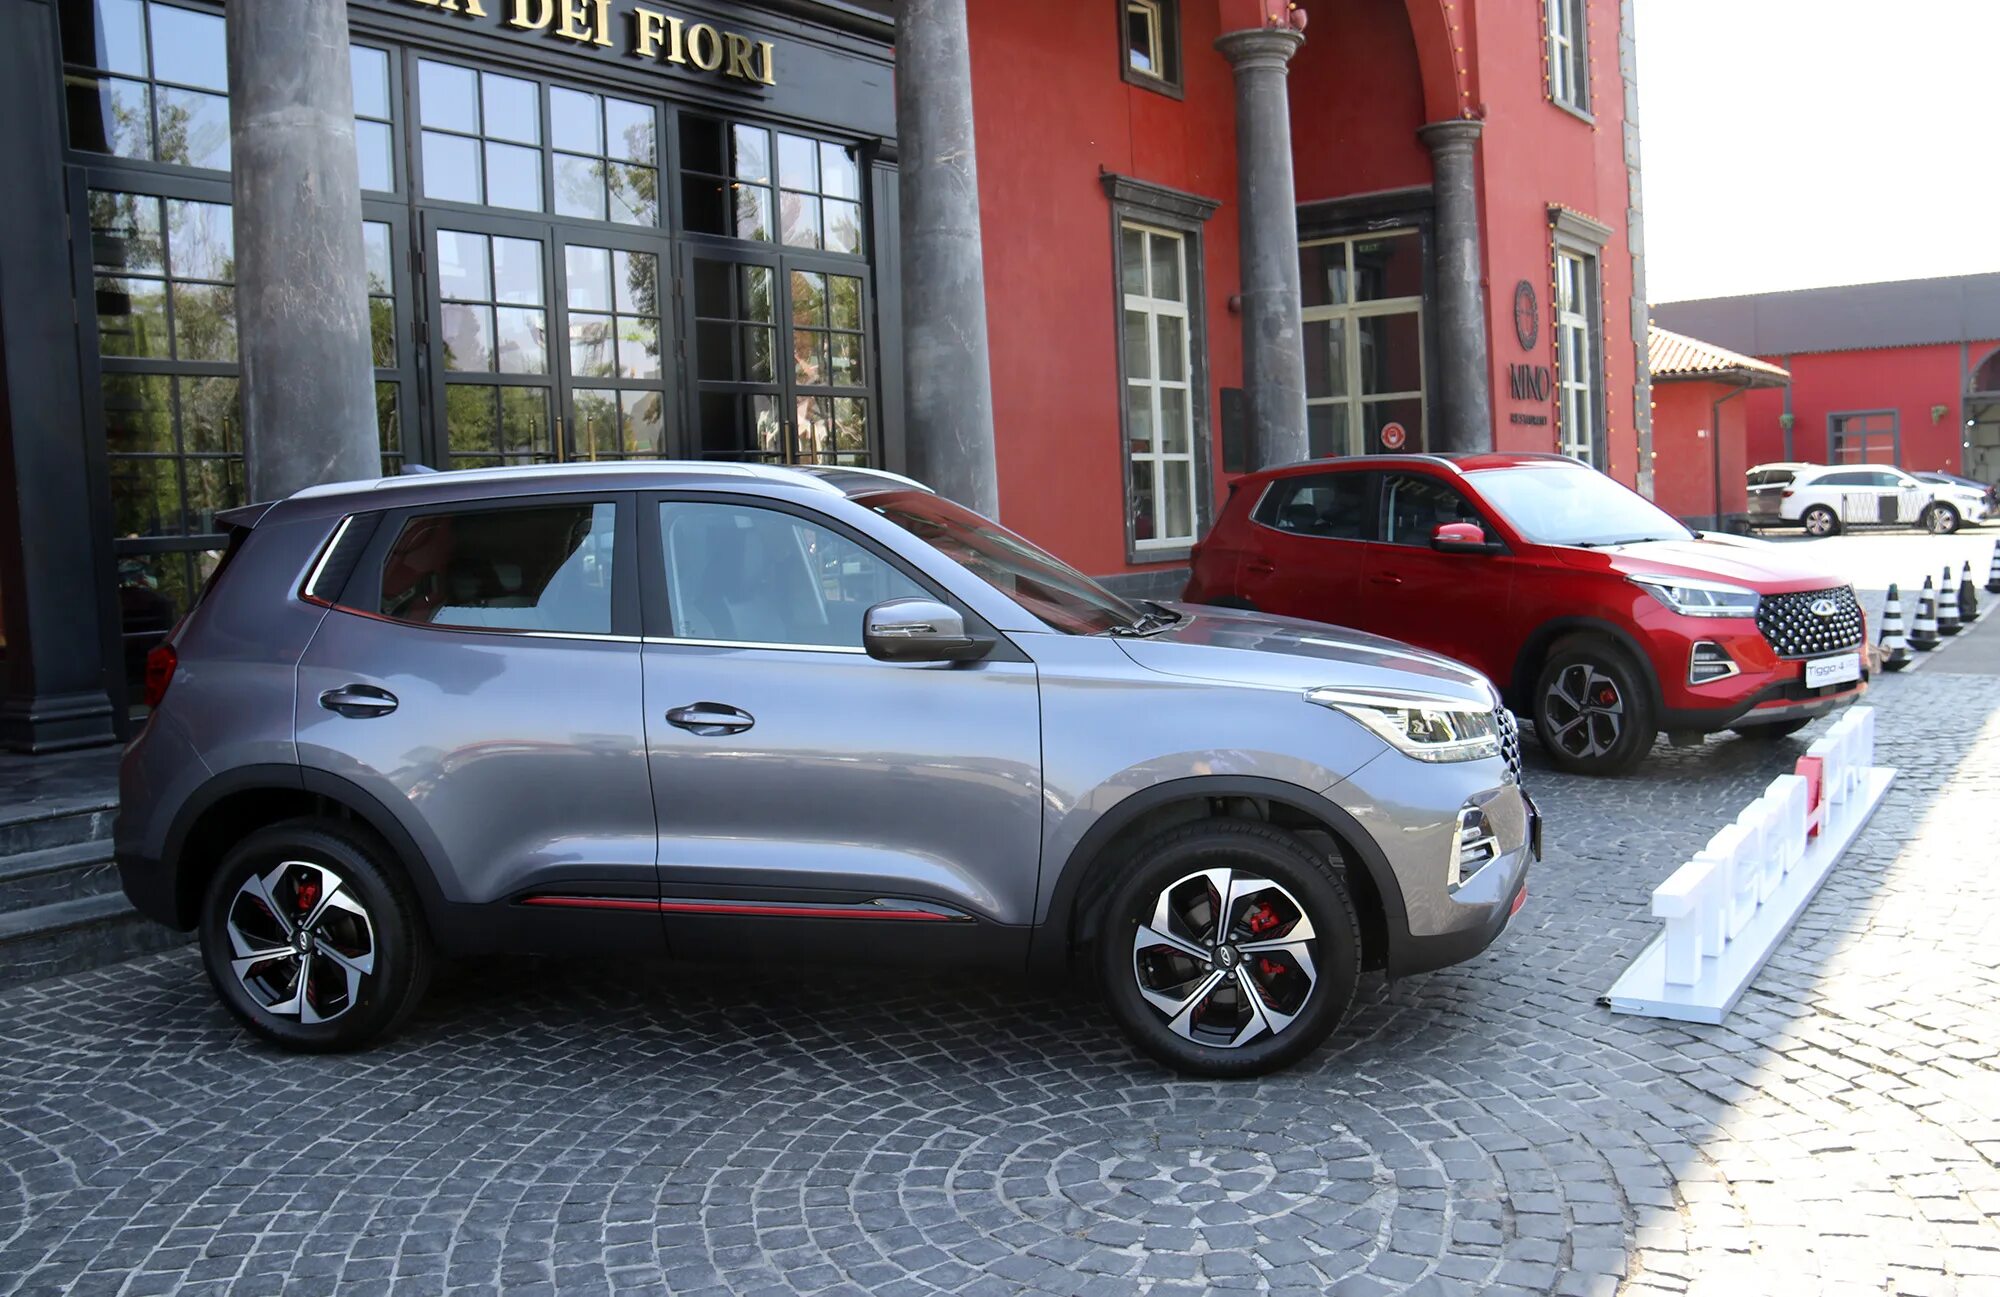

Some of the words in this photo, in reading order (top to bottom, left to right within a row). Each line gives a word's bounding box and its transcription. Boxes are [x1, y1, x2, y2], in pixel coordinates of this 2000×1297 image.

[509, 0, 614, 48] DEI
[634, 6, 776, 86] FIORI
[1510, 362, 1550, 402] NINO
